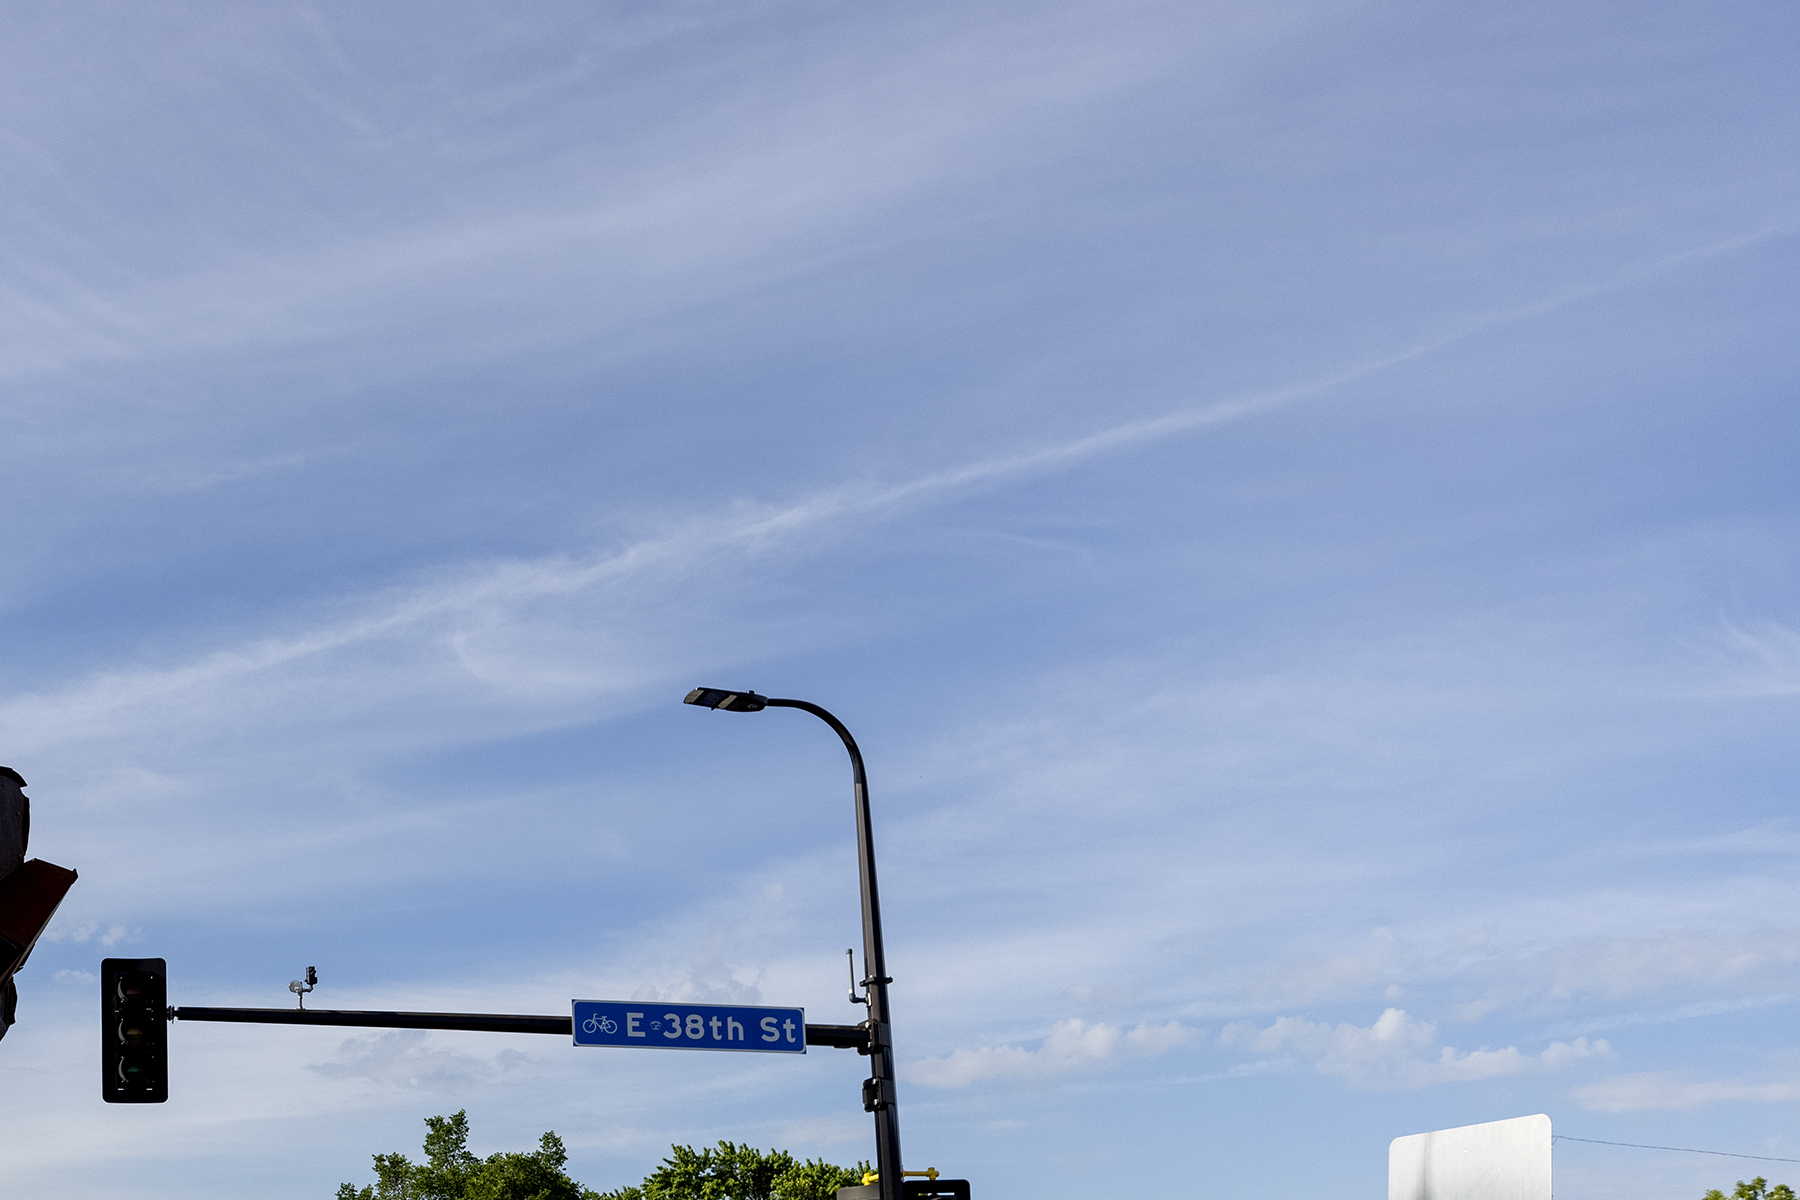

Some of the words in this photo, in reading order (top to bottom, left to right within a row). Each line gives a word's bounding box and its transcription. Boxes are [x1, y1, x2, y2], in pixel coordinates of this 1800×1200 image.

[627, 1012, 646, 1037] E
[663, 1013, 745, 1041] 38th
[760, 1017, 796, 1043] St
